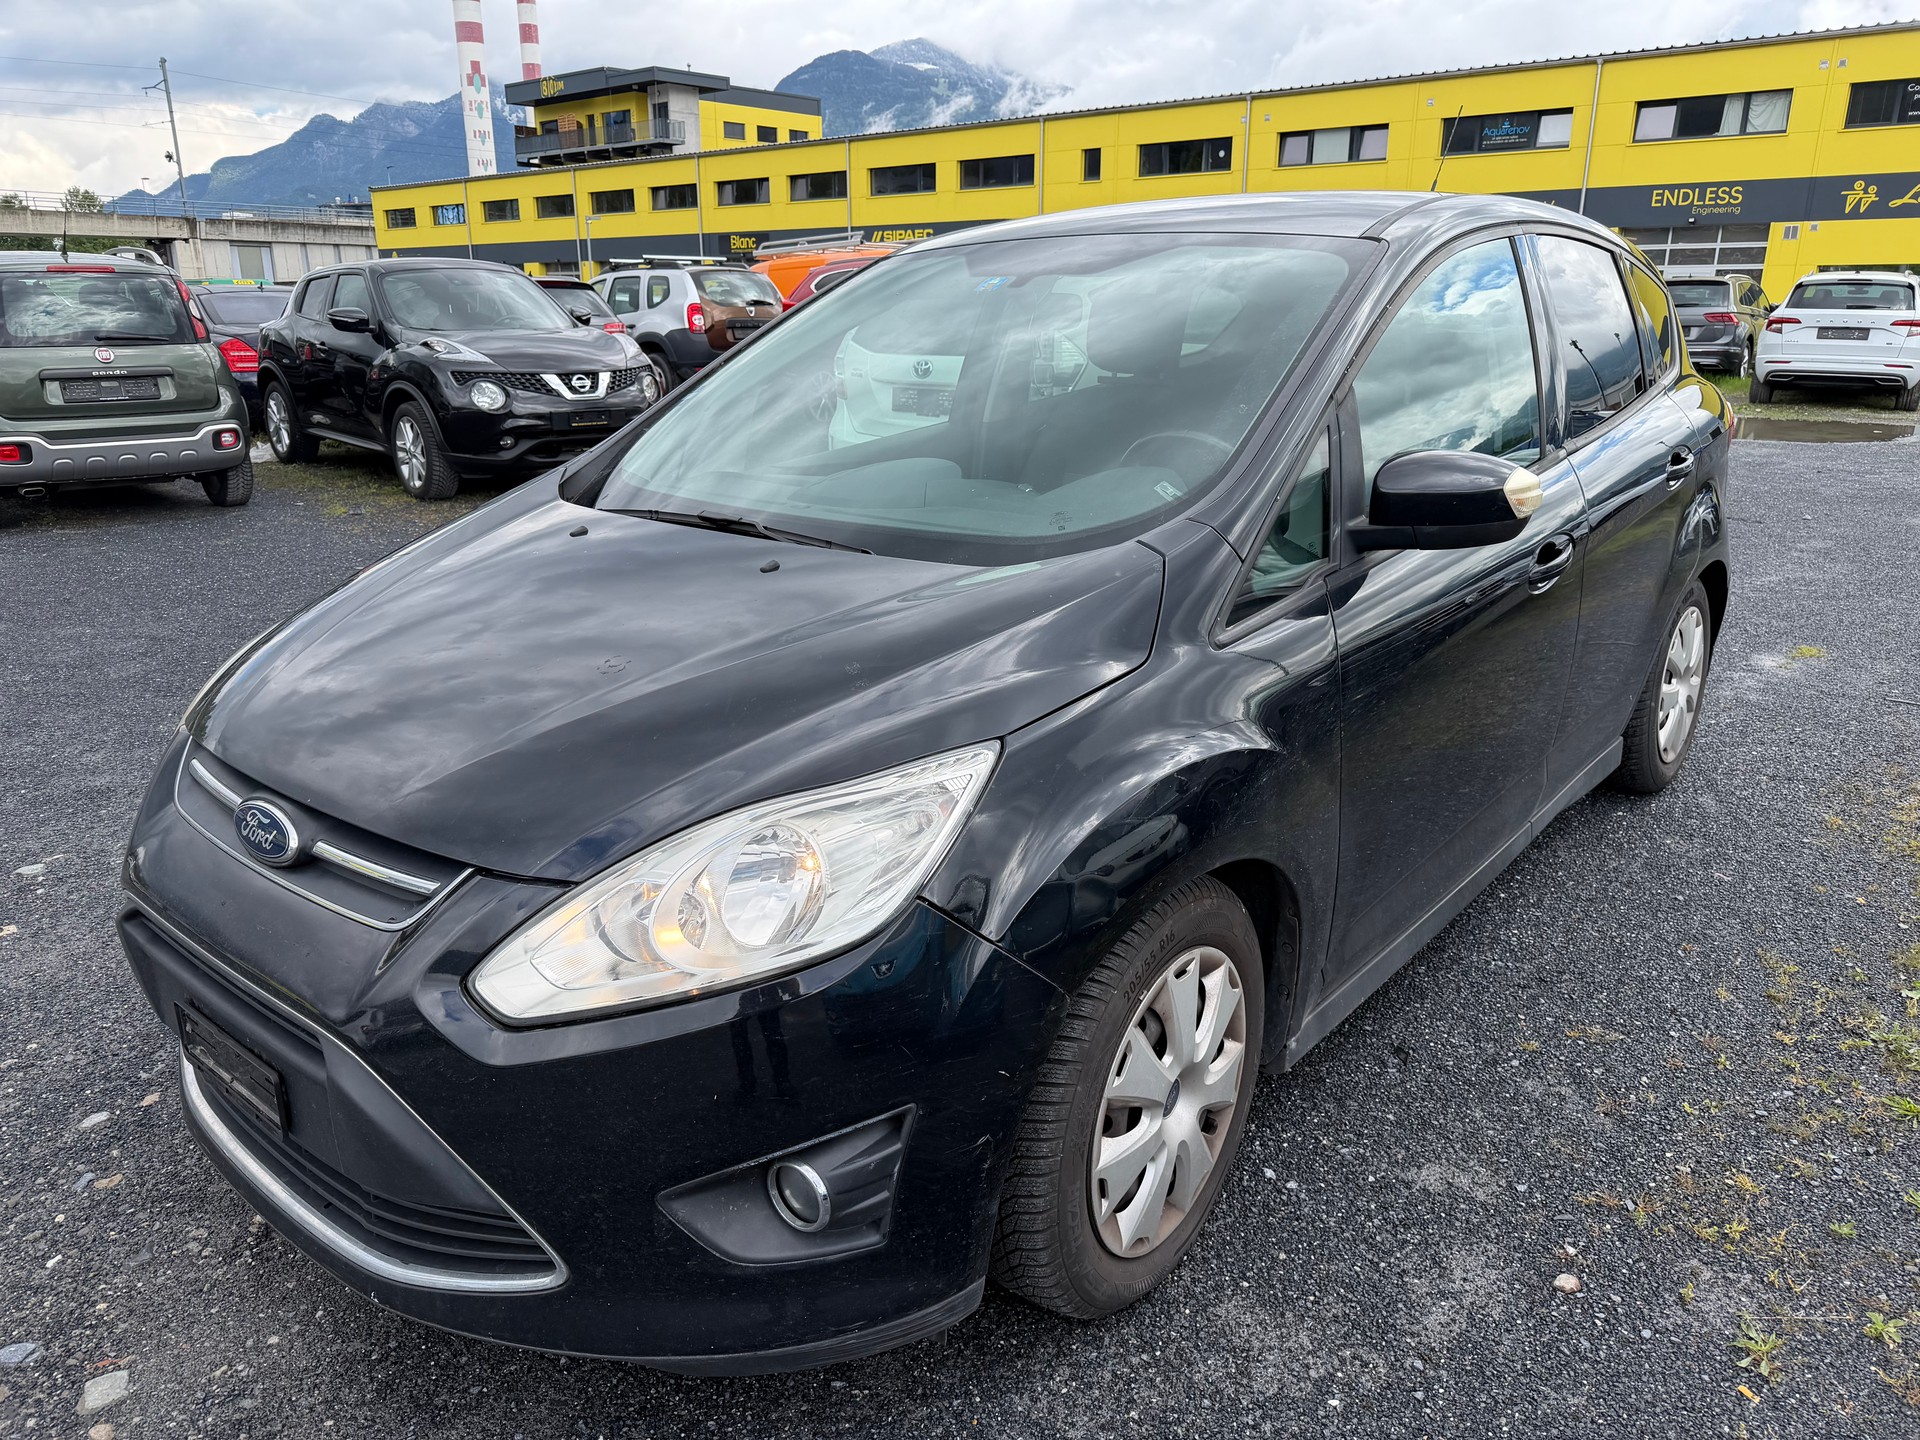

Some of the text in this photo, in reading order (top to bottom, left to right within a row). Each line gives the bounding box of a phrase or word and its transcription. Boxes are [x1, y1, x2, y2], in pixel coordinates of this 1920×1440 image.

[1482, 125, 1530, 137] Aquarenov
[1651, 186, 1743, 207] ENDLESS
[1692, 206, 1741, 216] Engineering
[730, 235, 757, 249] Blanc
[241, 809, 277, 850] Ford
[1123, 929, 1176, 1003] 205/55 R16
